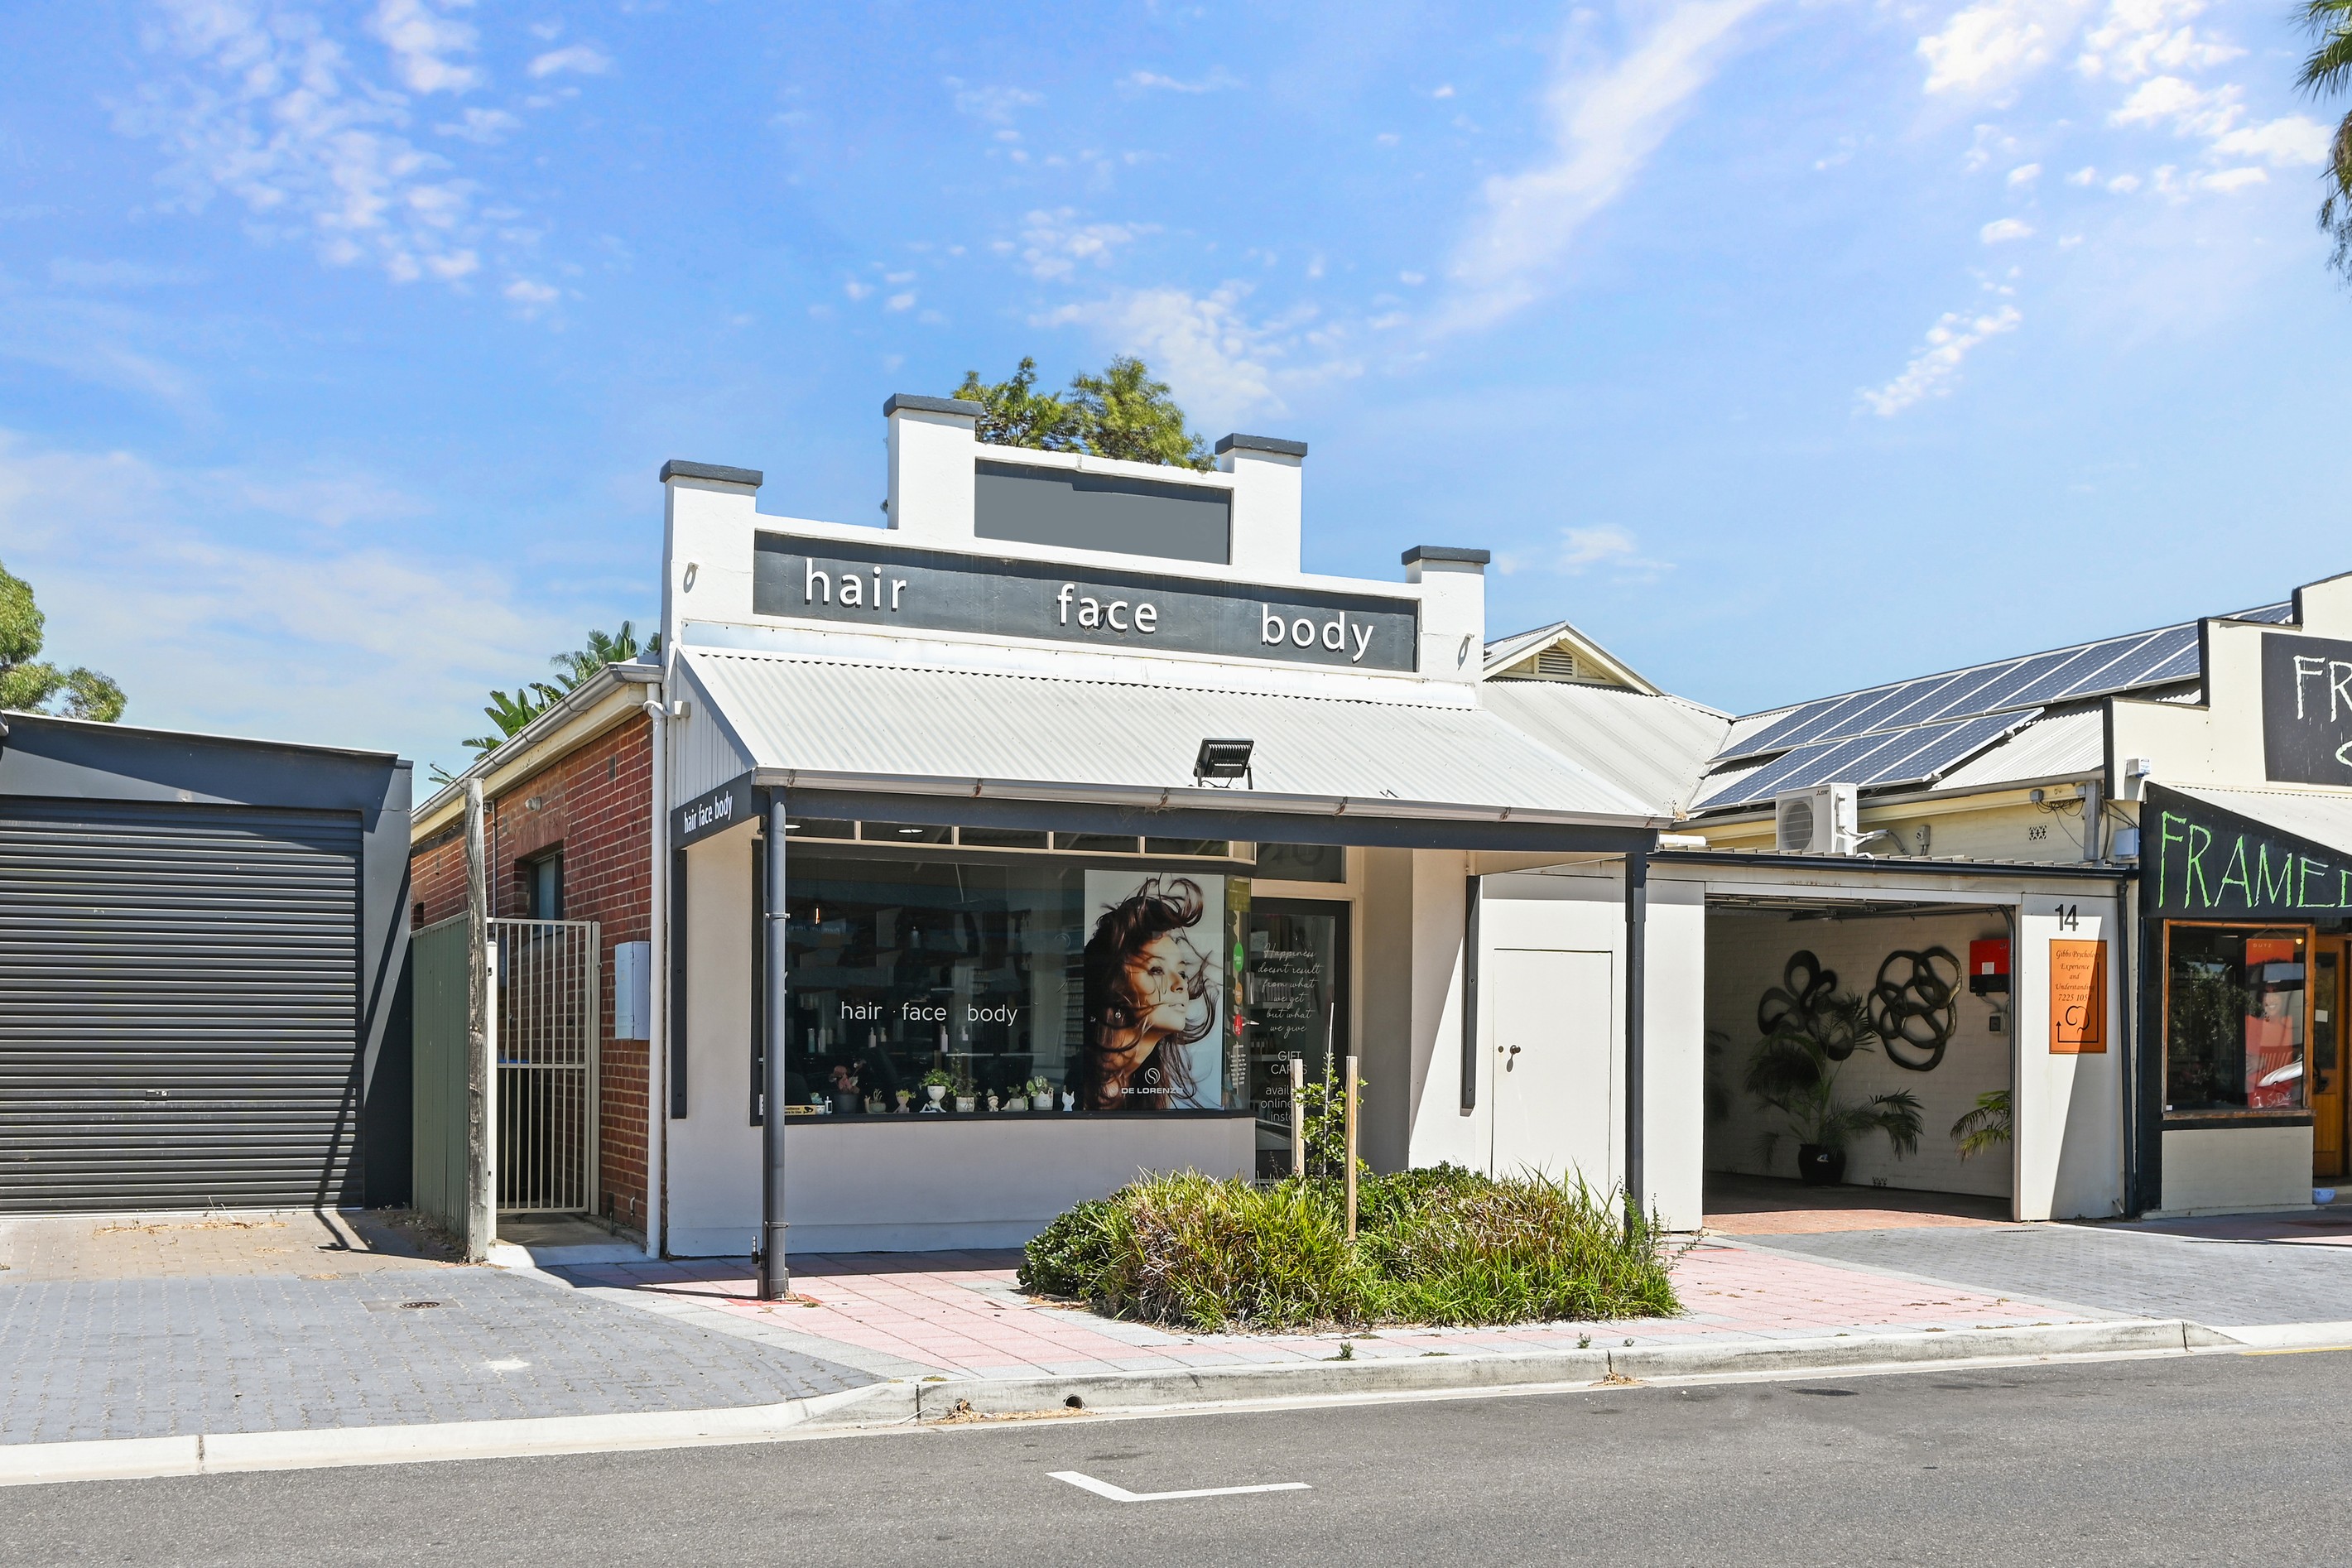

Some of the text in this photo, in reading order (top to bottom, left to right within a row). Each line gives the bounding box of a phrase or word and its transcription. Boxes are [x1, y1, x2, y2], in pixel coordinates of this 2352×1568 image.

[806, 557, 1374, 662] hair face body
[684, 790, 733, 834] hair face body
[2055, 904, 2079, 931] 14
[1263, 943, 1316, 961] Happiness
[2056, 949, 2071, 960] Gibbs
[1292, 963, 1324, 974] result
[2060, 963, 2090, 971] Experience
[1262, 977, 1319, 993] from what
[2055, 983, 2095, 993] Understanding
[1287, 992, 1309, 1009] get
[2058, 993, 2074, 1002] 7225
[841, 1001, 1018, 1027] hair face body
[1267, 1007, 1315, 1019] but what
[1284, 1026, 1307, 1039] give
[1277, 1051, 1301, 1061] GIFT
